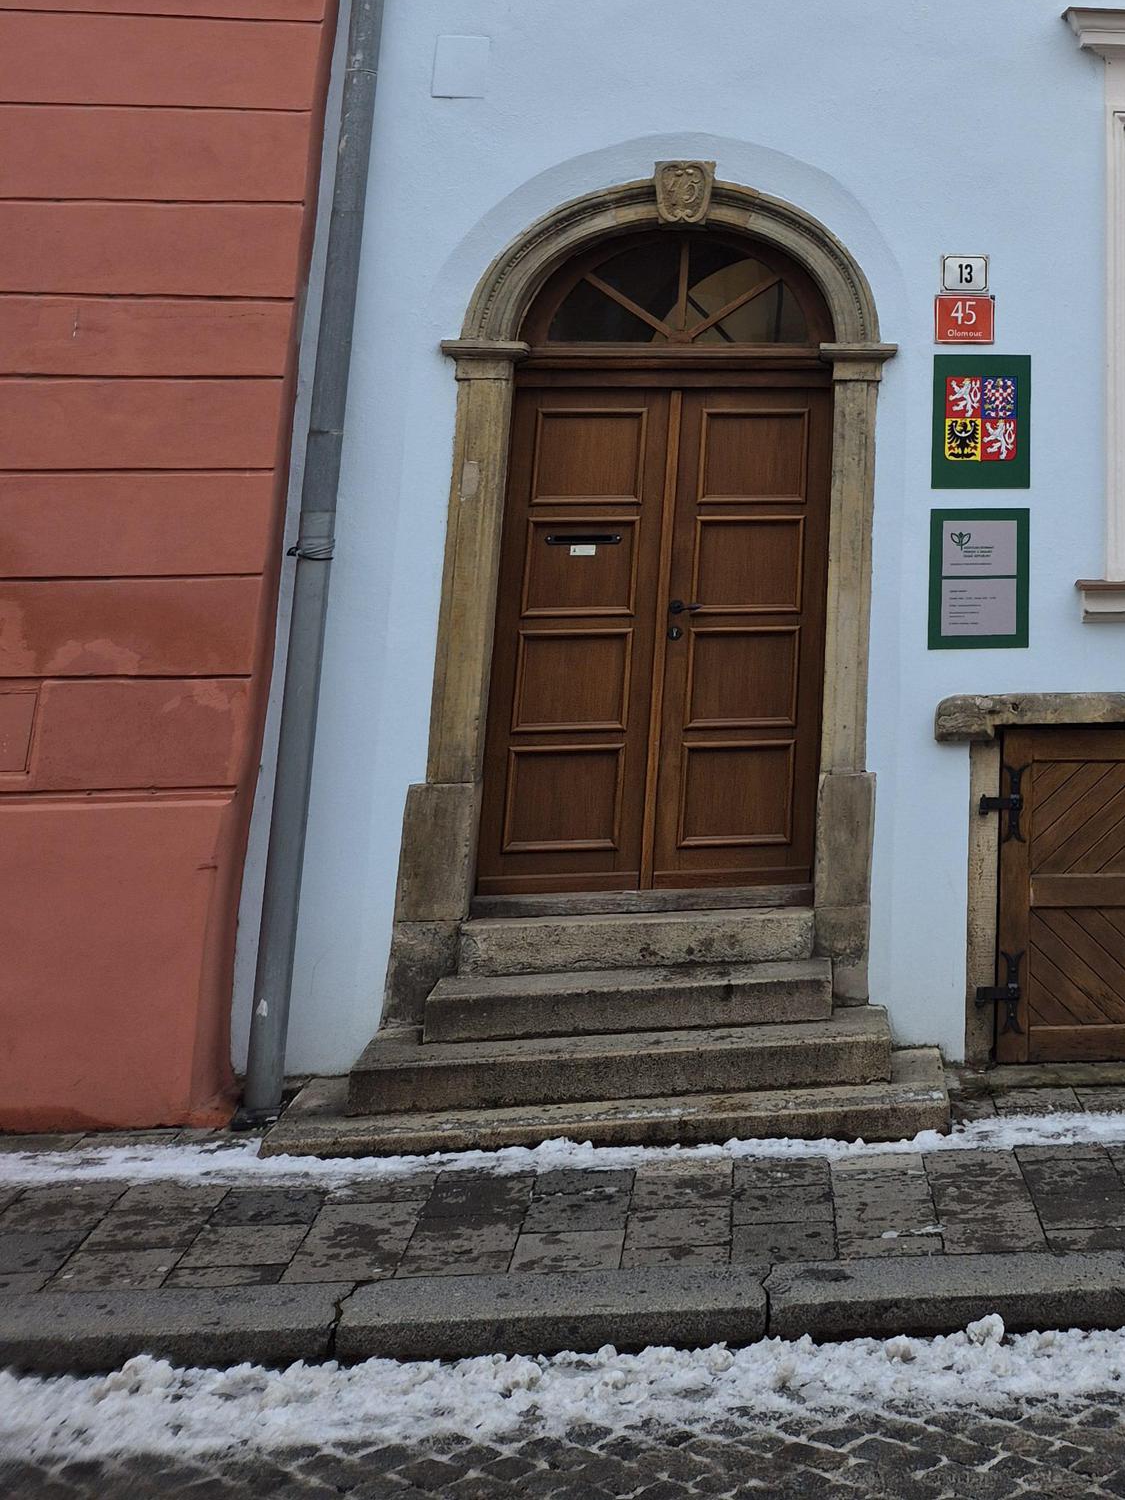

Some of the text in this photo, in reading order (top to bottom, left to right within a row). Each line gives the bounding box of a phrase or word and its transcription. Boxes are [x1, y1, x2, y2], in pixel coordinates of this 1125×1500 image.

[958, 263, 973, 284] 13
[950, 301, 977, 325] 45
[947, 328, 983, 337] Olomouc
